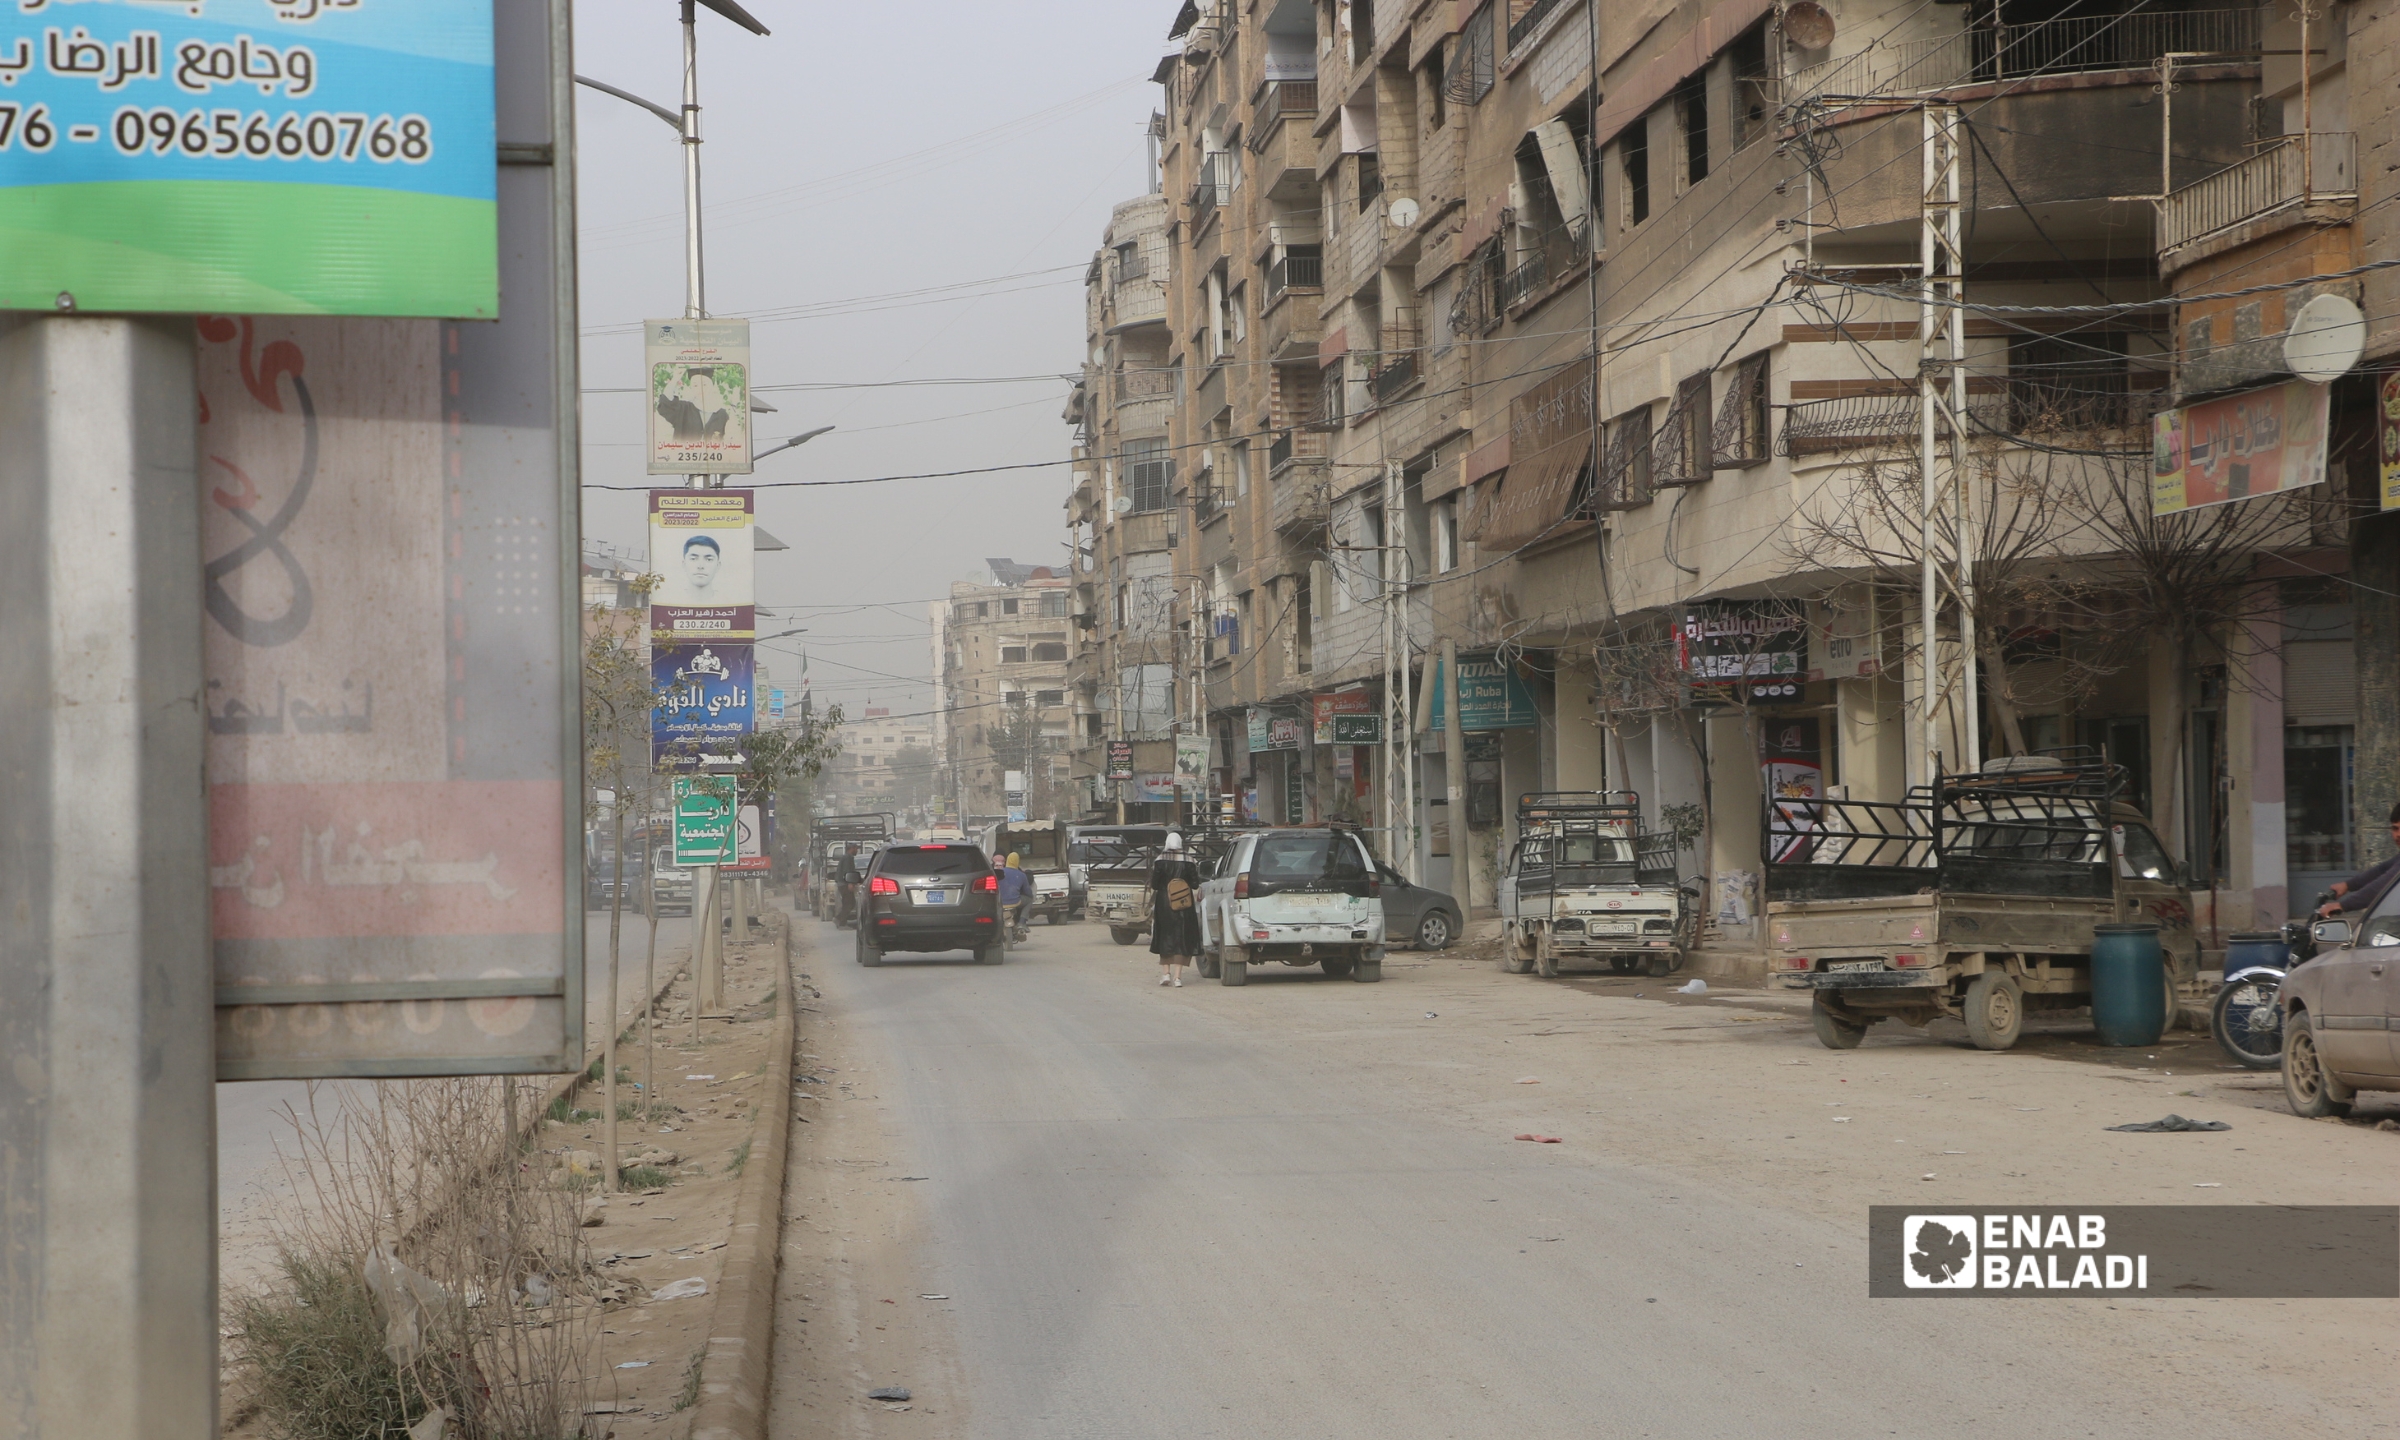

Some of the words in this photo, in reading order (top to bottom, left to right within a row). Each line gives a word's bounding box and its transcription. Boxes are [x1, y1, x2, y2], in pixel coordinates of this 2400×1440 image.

[49, 31, 156, 87] الرضا
[177, 39, 312, 93] وجامع
[116, 110, 429, 160] 0965660768
[657, 441, 683, 450] سليمان
[685, 441, 705, 450] الدين
[2189, 412, 2231, 479] داريا
[678, 452, 723, 461] 235/240
[661, 498, 688, 506] العلم
[690, 498, 711, 506] مداد
[714, 498, 742, 506] معهد
[667, 608, 694, 618] العزب
[695, 608, 714, 618] زهير
[715, 607, 737, 616] أحمد
[679, 620, 726, 628] 230.2/240
[1475, 685, 1502, 698] Ruba
[658, 685, 704, 714] القوة
[707, 685, 747, 716] نادي
[679, 804, 730, 820] داريا
[679, 823, 730, 841] المجتمعية
